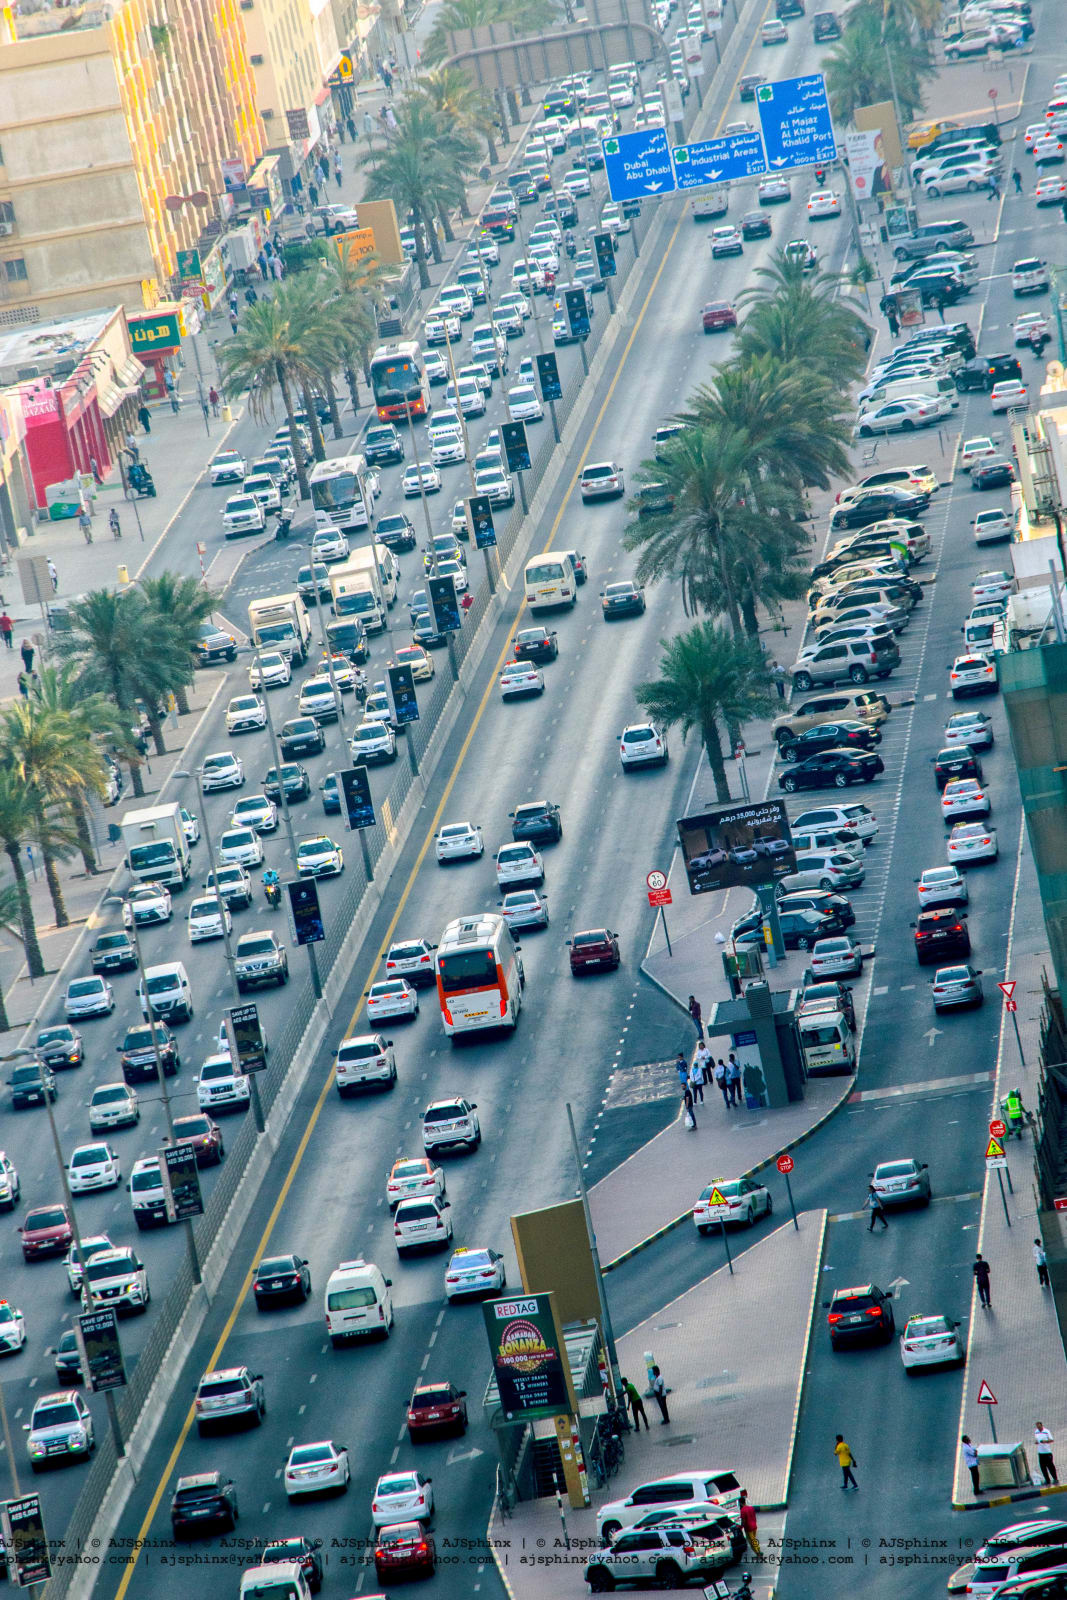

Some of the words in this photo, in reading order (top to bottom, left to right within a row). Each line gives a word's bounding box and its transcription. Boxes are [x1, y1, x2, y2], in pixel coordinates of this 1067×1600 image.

[780, 121, 790, 130] Al
[792, 116, 818, 128] Majaz
[781, 131, 792, 140] Al
[793, 126, 817, 137] Khan
[782, 135, 810, 149] Khalid
[812, 131, 832, 142] Port
[691, 151, 730, 167] Industrial
[733, 147, 759, 158] Areas
[816, 151, 834, 161] EXIT
[623, 160, 649, 171] Dubai
[746, 165, 764, 175] EXIT
[626, 171, 644, 181] Abu
[645, 164, 671, 177] Dhabi
[652, 879, 662, 887] 60
[166, 1150, 178, 1158] SAVE
[496, 1302, 537, 1317] REDTAG
[81, 1318, 96, 1326] SAVE
[506, 1331, 537, 1342] RAMADAN
[498, 1337, 547, 1356] BONANZA
[515, 1383, 526, 1391] 15
[527, 1381, 549, 1389] WINNERS
[8, 1504, 22, 1513] SAVE
[23, 1502, 31, 1510] UP
[31, 1499, 38, 1507] TO
